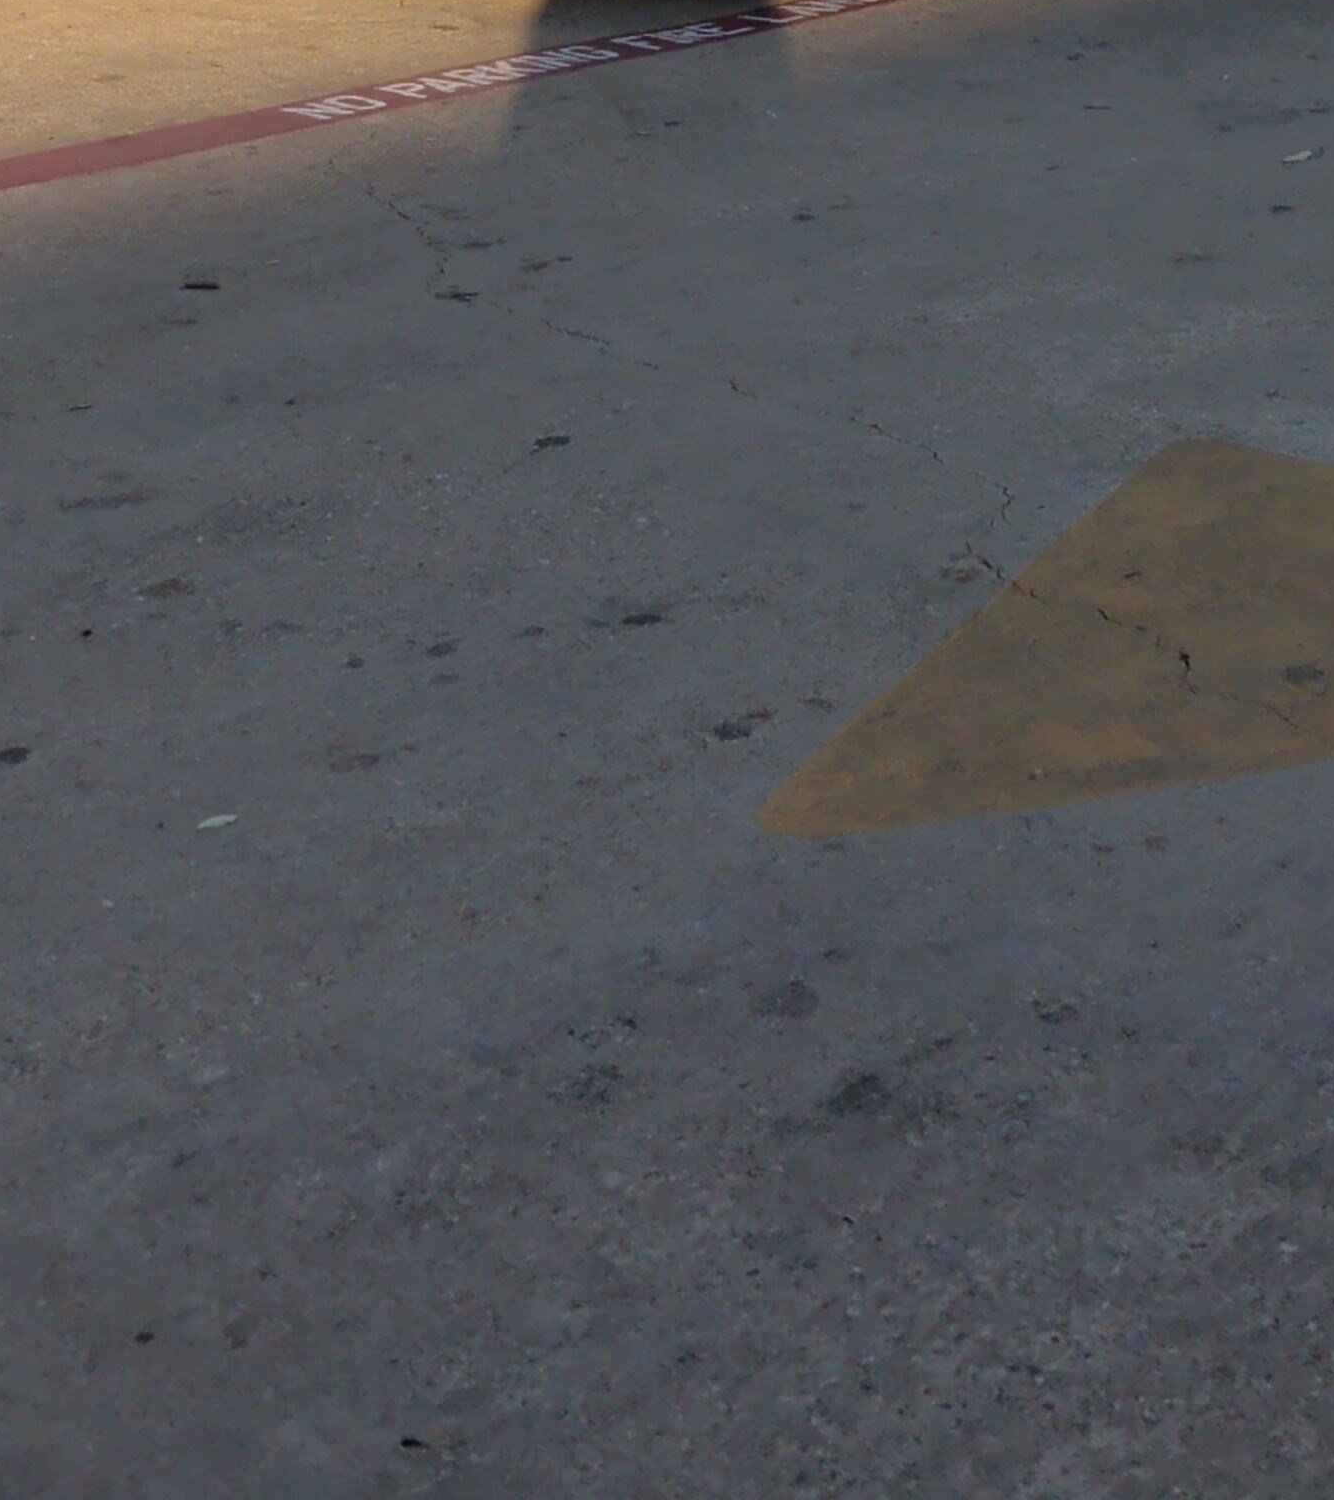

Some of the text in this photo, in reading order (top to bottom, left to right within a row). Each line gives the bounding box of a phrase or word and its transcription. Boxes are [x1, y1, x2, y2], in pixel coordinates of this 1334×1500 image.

[280, 95, 387, 120] NO
[374, 44, 619, 99] PARKING
[610, 22, 755, 50] FIRE
